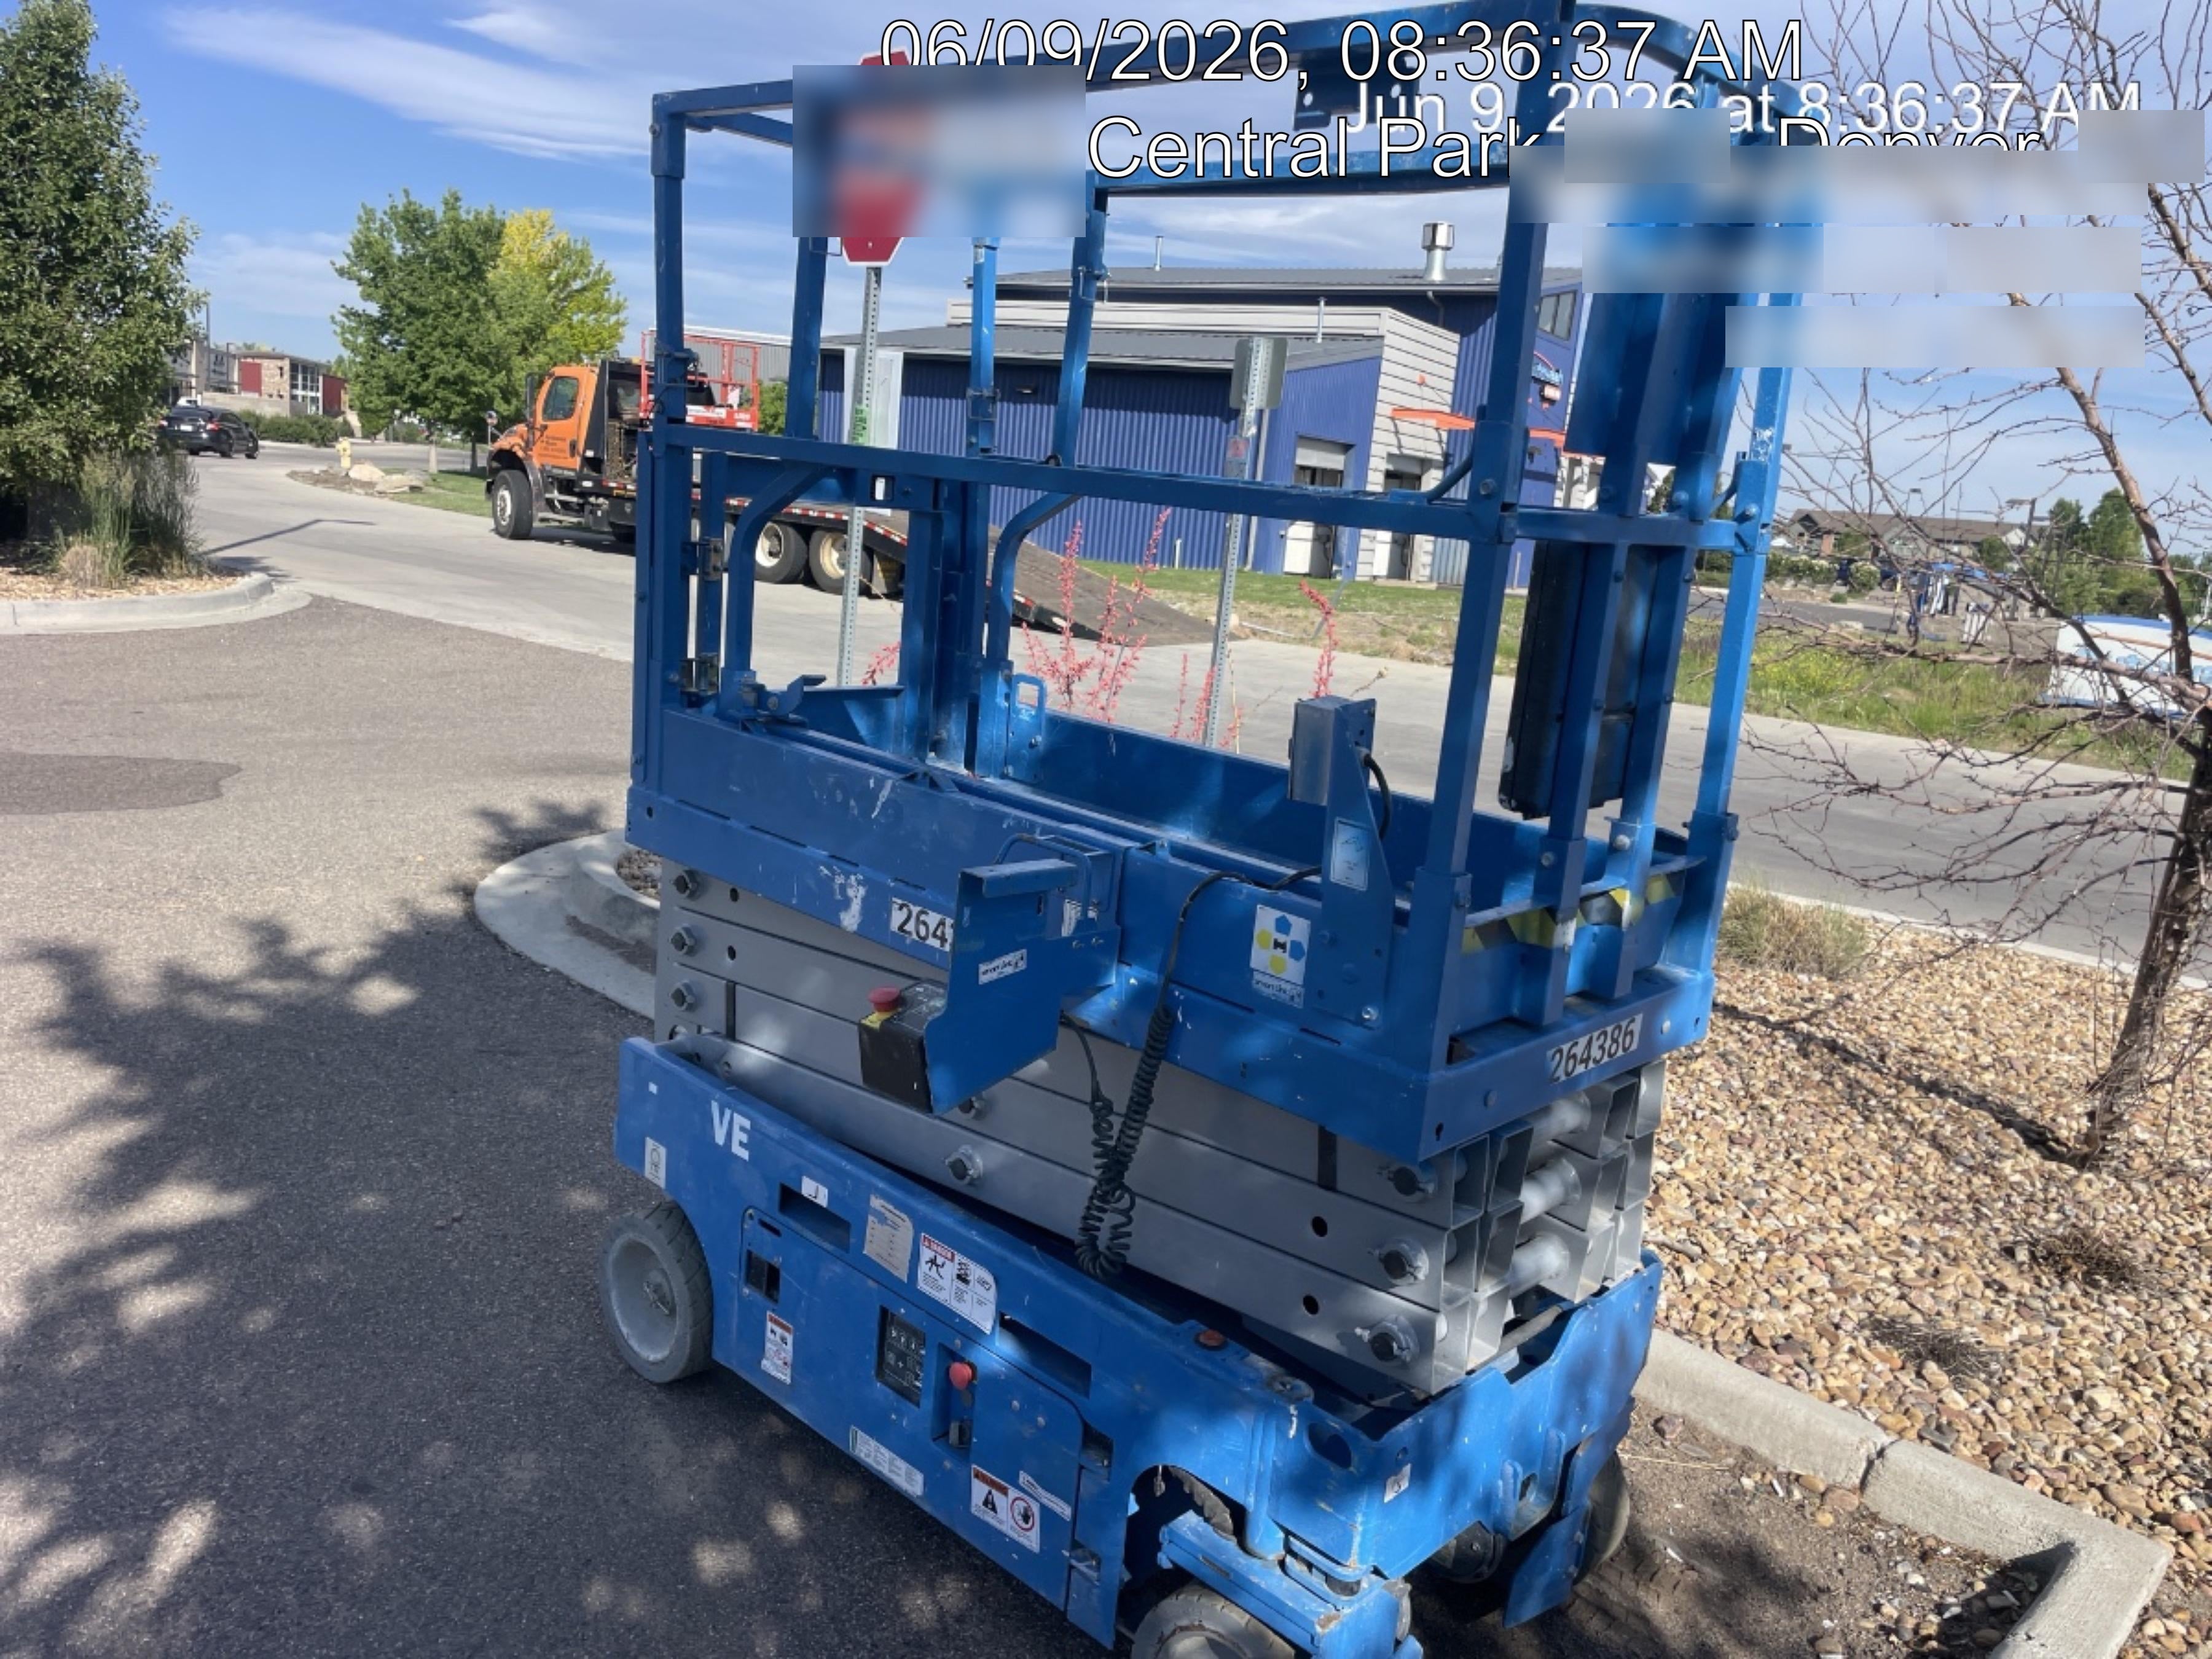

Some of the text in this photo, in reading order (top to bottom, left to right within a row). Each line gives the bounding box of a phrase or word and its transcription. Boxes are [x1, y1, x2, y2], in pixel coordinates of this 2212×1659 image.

[898, 902, 954, 948] 264
[1549, 1017, 1636, 1083] 264386
[711, 1100, 751, 1162] VE
